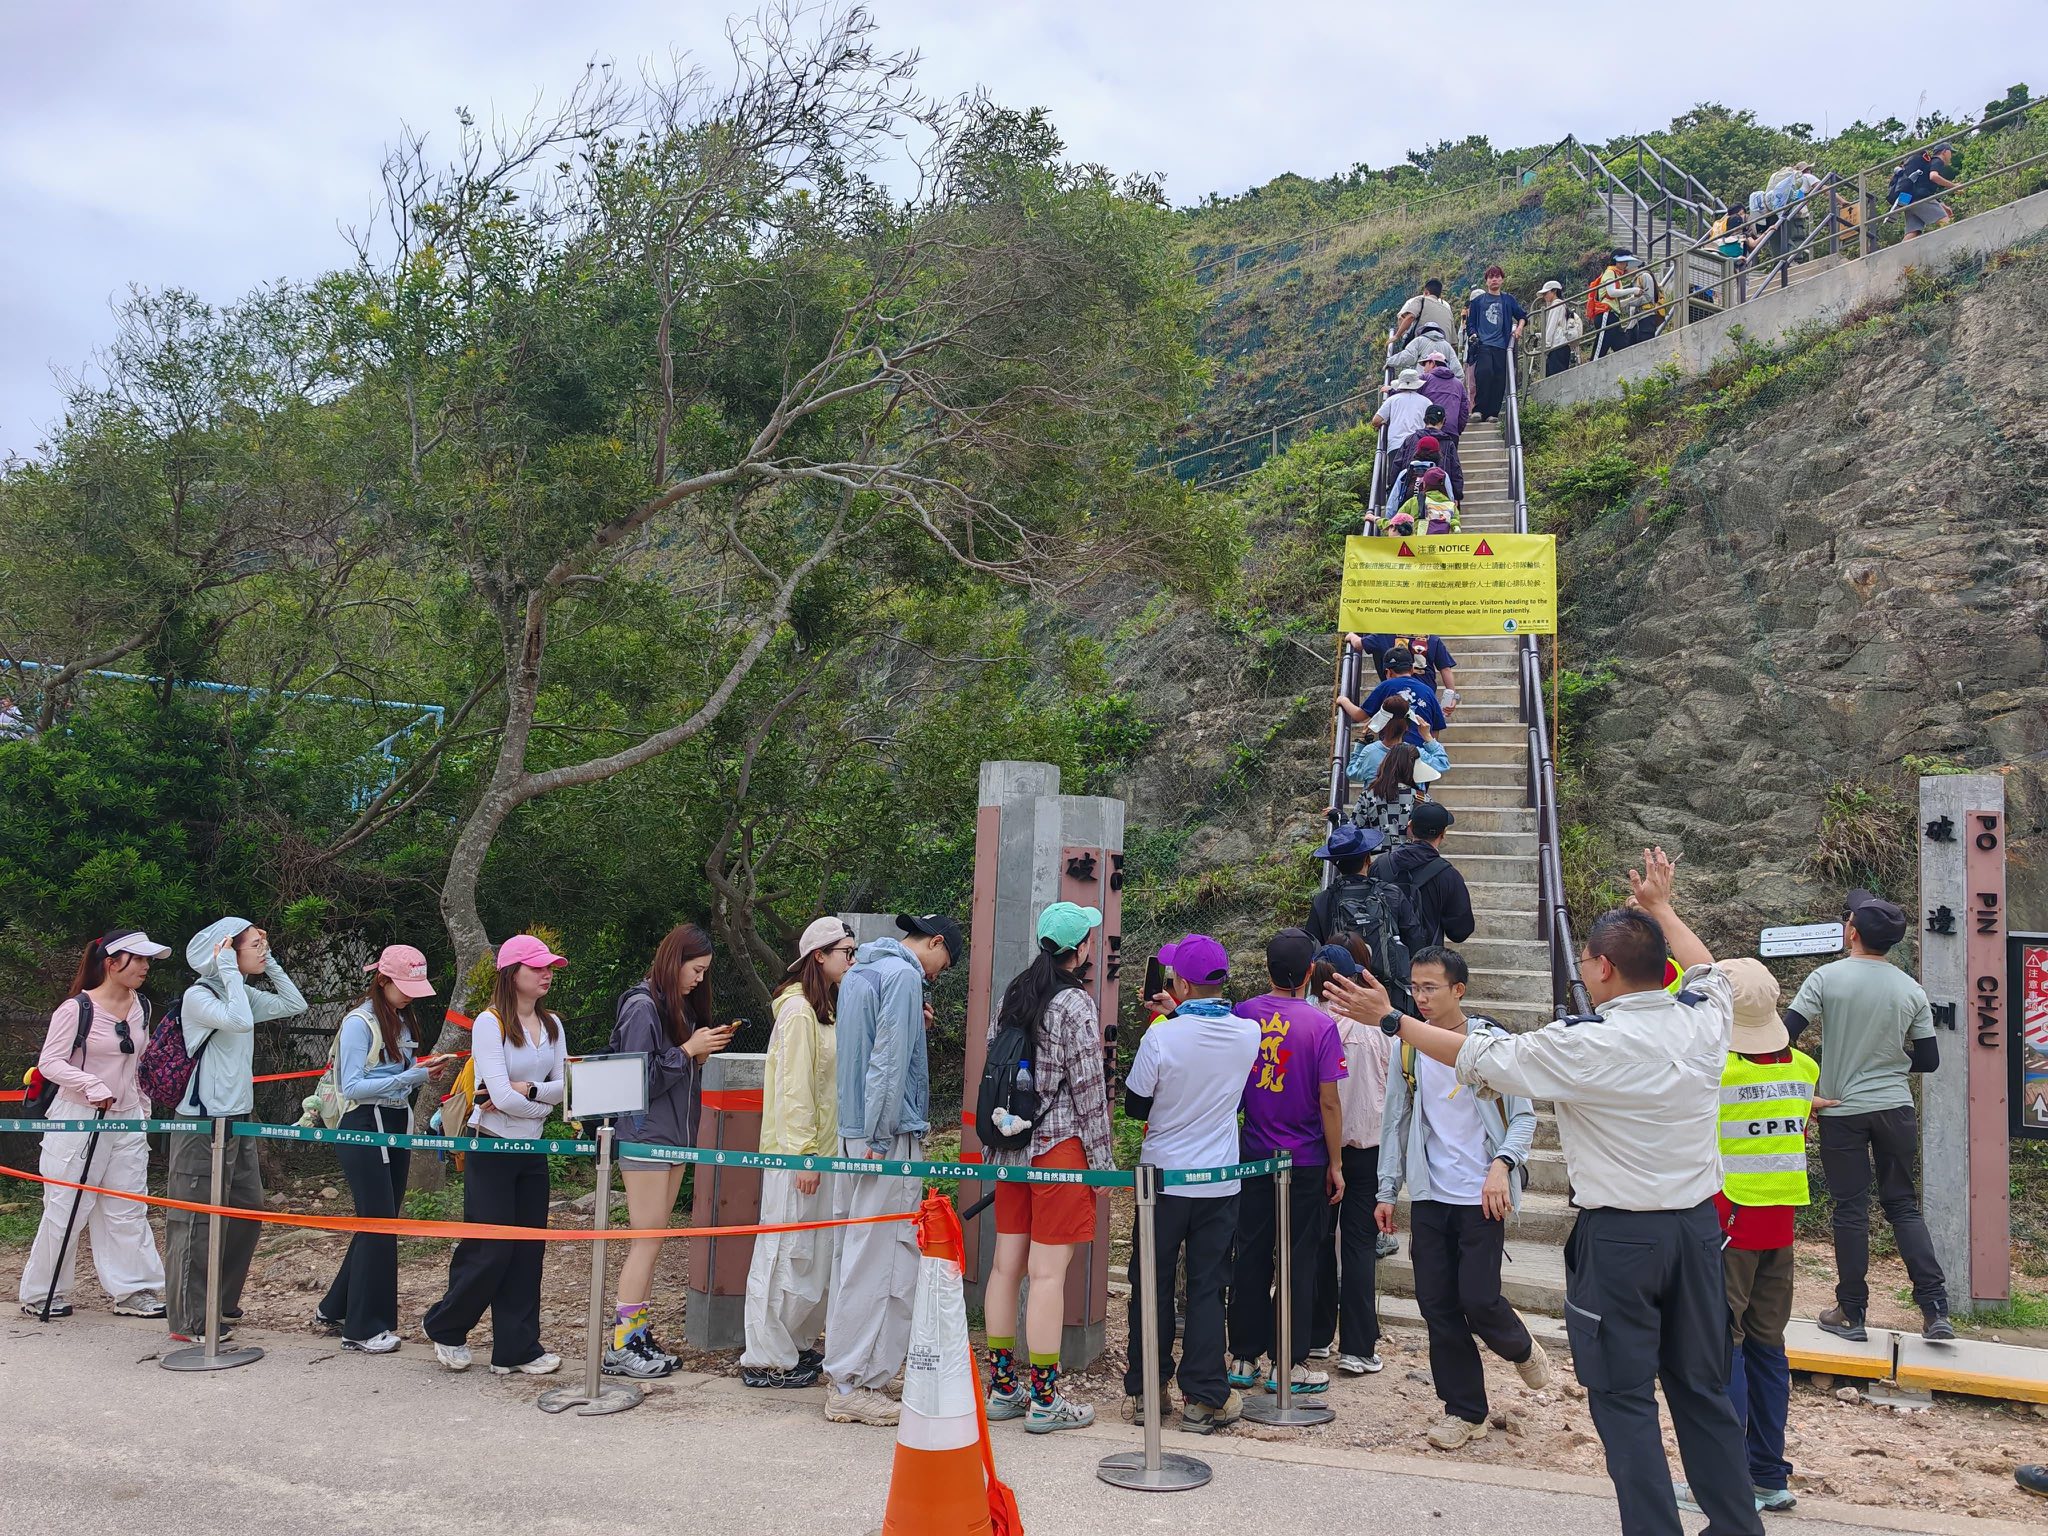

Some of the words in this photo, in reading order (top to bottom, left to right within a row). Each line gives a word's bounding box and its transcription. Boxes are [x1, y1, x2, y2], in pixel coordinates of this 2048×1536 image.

[1417, 544, 1437, 555] 注意
[1439, 544, 1470, 553] NOTICE
[1422, 599, 1450, 607] currently
[1460, 599, 1478, 607] place.
[1504, 598, 1529, 606] heading
[1390, 607, 1415, 615] Viewing
[1444, 607, 1465, 615] please
[1502, 607, 1531, 615] patiently.
[1976, 815, 1998, 851] PO
[1976, 892, 1998, 935] PIN
[2028, 968, 2039, 1012] 注意事項
[1977, 975, 2000, 1048] CHAU
[96, 1121, 129, 1130] A.F.C.D.
[336, 1132, 375, 1143] A.F.C.D.
[493, 1142, 535, 1150] A.F.C.D.
[650, 1148, 699, 1161] 漁農自然護理署
[741, 1155, 787, 1166] A.F.C.D.
[831, 1161, 883, 1173] 漁農自然護理署
[929, 1165, 979, 1176] A.F.C.D.
[1026, 1170, 1083, 1183] 漁農自然護理署
